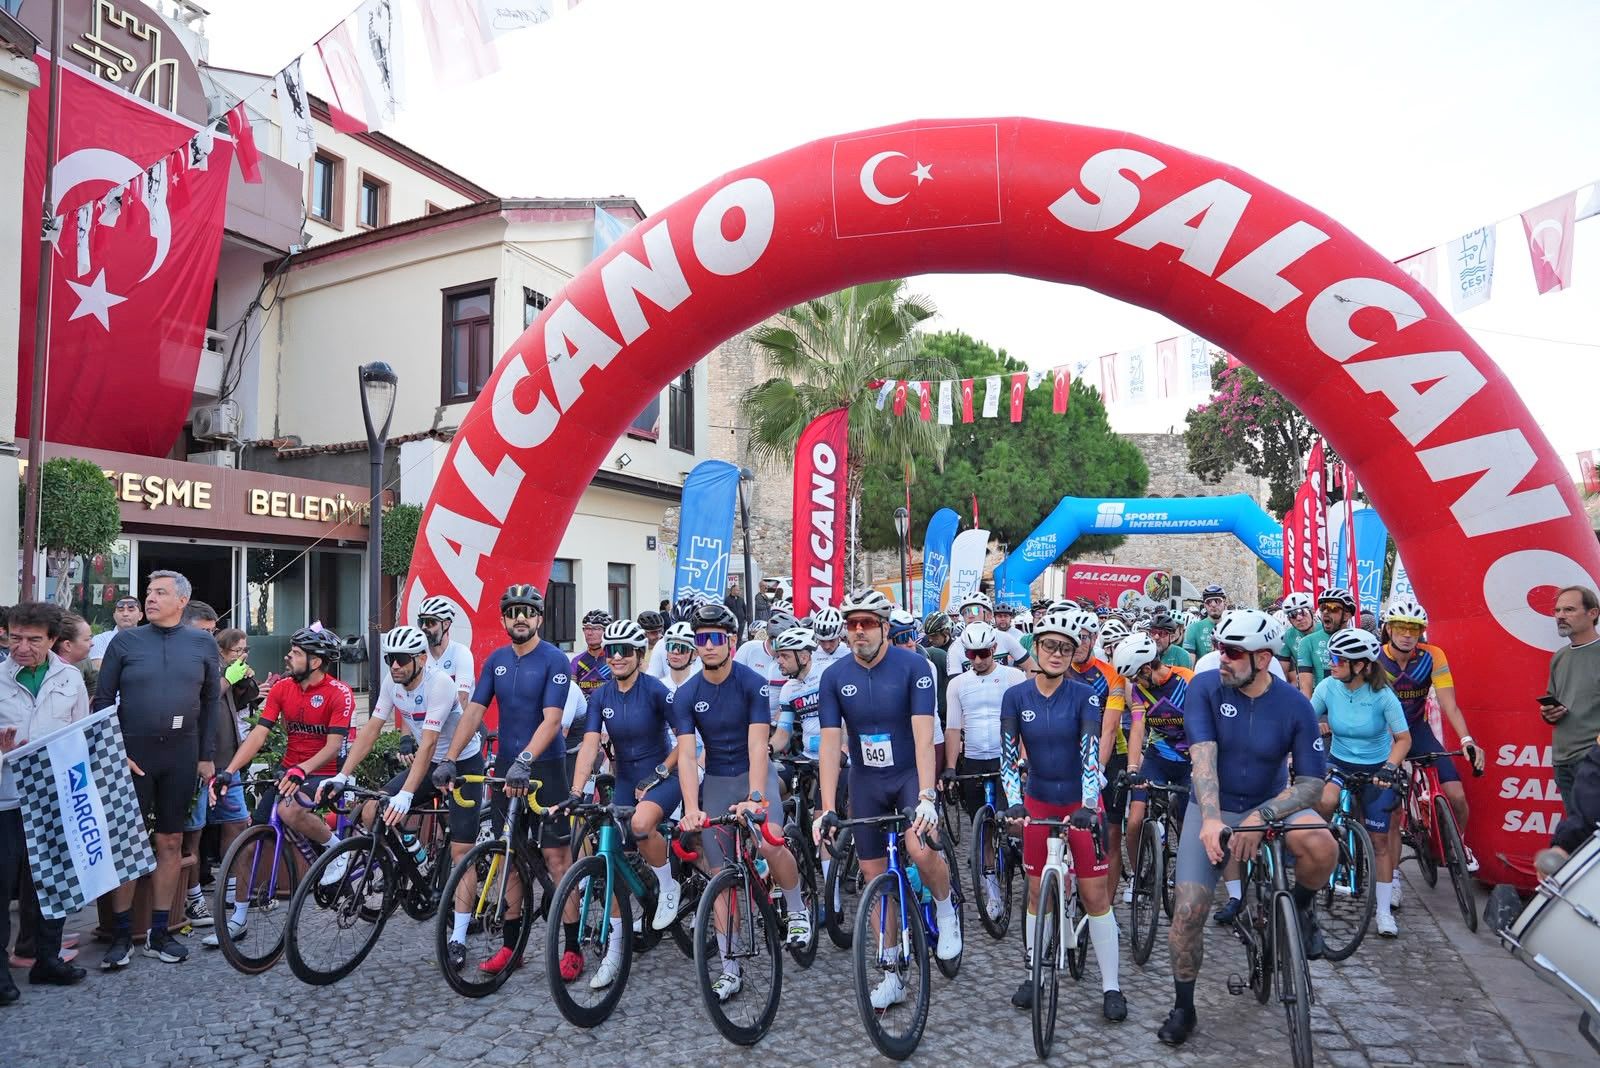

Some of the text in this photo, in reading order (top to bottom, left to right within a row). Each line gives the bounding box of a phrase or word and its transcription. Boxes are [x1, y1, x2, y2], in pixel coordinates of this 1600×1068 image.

[1048, 148, 1600, 652] SALCANO
[1124, 512, 1168, 520] SPORTS
[809, 442, 837, 617] ALCANO
[1129, 519, 1219, 528] INTERNATIONAL
[1072, 571, 1141, 583] SALCANO
[1395, 582, 1413, 595] ÇE
[866, 748, 885, 762] 649
[1499, 777, 1564, 801] SAL
[72, 793, 103, 867] ARGEUS
